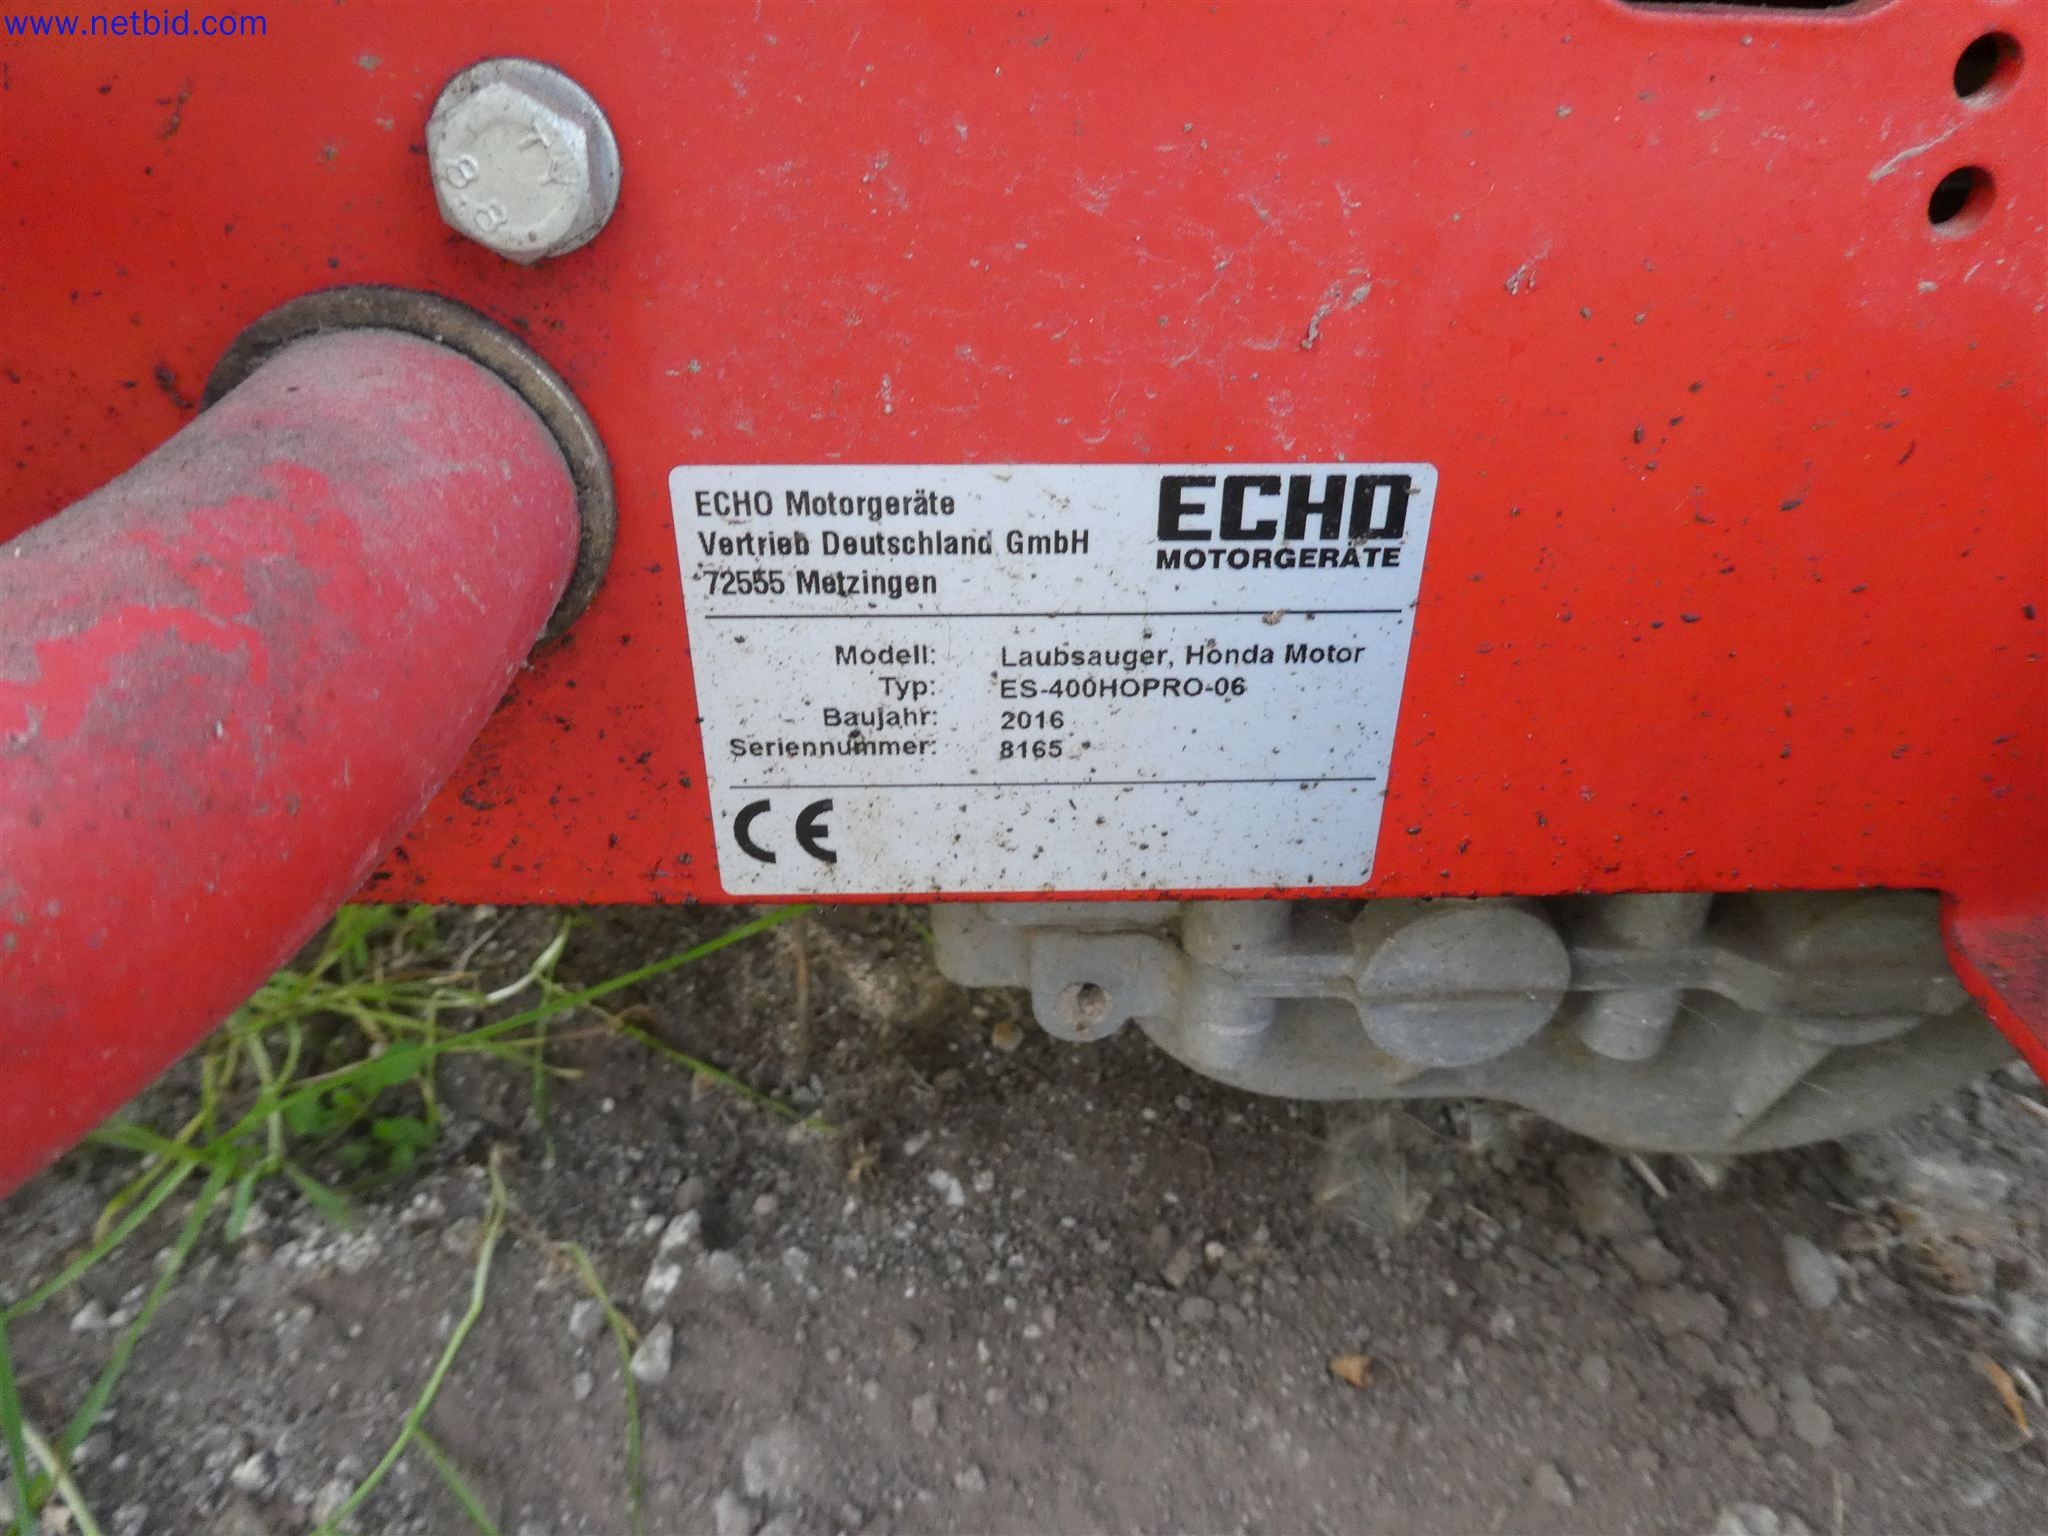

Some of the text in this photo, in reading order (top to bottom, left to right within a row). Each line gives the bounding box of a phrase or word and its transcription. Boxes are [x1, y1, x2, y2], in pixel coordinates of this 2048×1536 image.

[695, 488, 956, 521] ECHO Motorgeräte
[1157, 474, 1411, 540] ECHO
[698, 529, 1090, 556] Vertrieb Deutschland GmbH
[704, 569, 937, 599] 72555 Metzingen
[835, 643, 1366, 670] Modell: Laubsauger, Honda Motor
[879, 676, 1247, 700] Typ: ES-400HOPRO-06
[823, 708, 1064, 731] Baujahr: 2016
[730, 738, 1063, 758] Seriennummer: 8165
